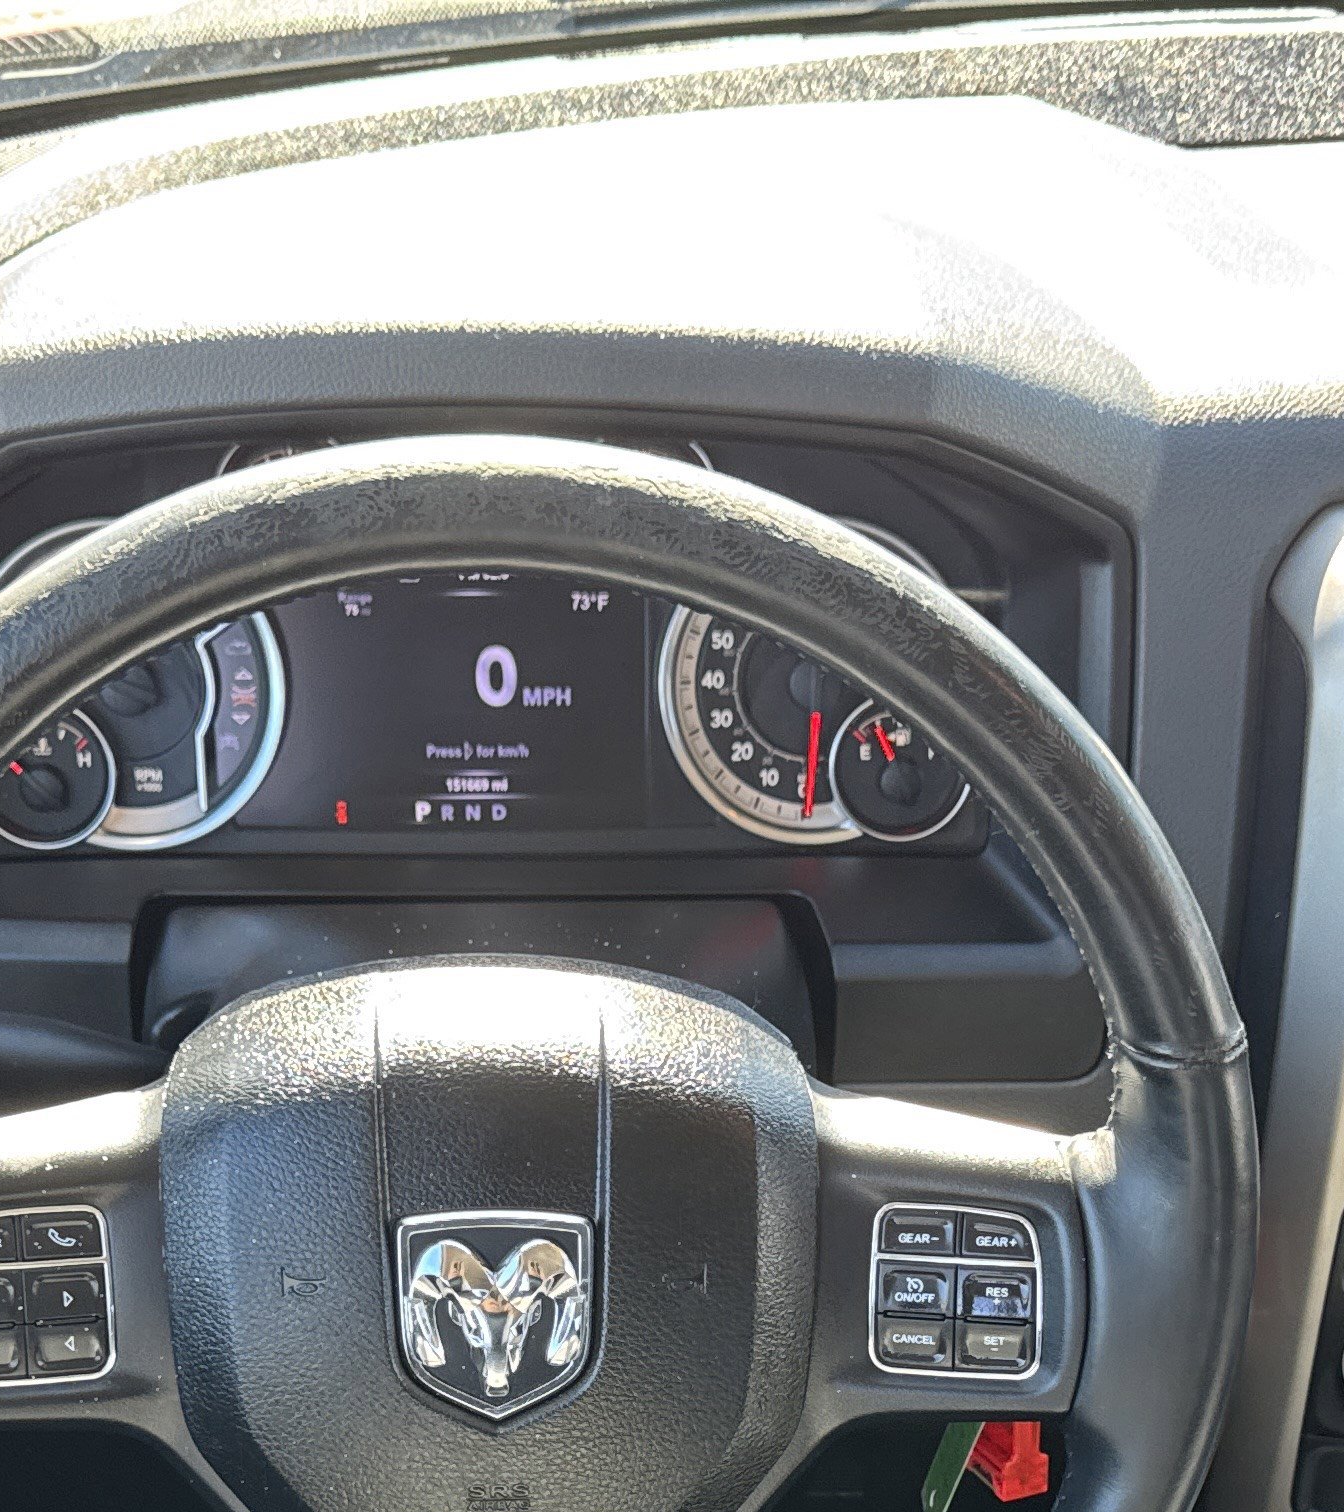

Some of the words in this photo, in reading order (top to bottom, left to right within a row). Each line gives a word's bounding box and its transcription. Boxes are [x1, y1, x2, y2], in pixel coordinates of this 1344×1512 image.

[711, 629, 734, 650] 50
[475, 644, 518, 708] 0
[701, 669, 725, 690] 40
[522, 685, 572, 706] MPH
[710, 708, 733, 728] 30
[76, 751, 92, 768] H
[731, 741, 754, 762] 20
[759, 767, 780, 787] 10
[415, 800, 432, 823] P
[440, 803, 455, 822] R
[465, 803, 482, 822] N
[491, 802, 508, 821] D
[985, 1286, 1009, 1298] RES
[892, 1333, 936, 1346] CANCEL
[983, 1336, 1006, 1346] SET
[468, 1484, 531, 1498] SRS
